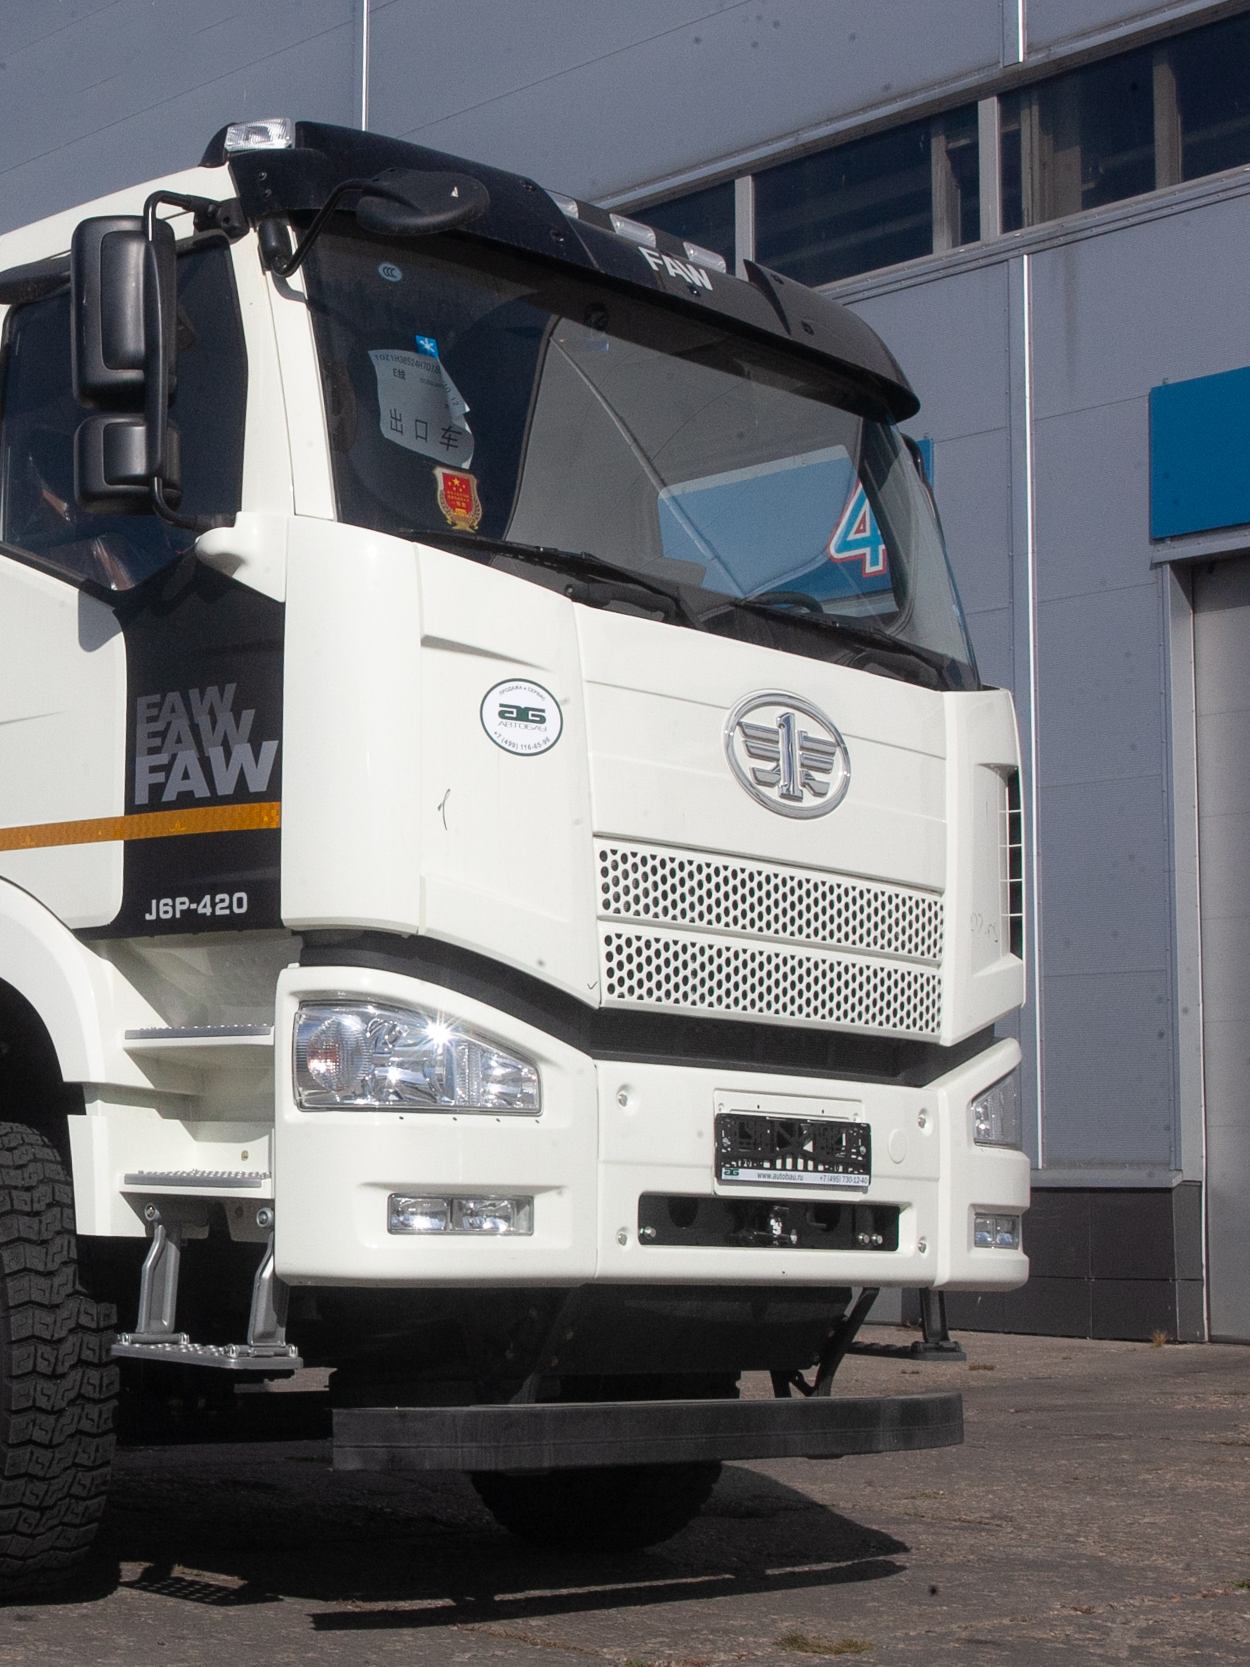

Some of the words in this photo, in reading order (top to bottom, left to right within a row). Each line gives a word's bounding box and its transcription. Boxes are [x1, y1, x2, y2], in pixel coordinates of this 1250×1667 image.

[638, 247, 713, 291] FAW
[388, 407, 462, 451] 出口车
[826, 478, 887, 578] 4
[137, 682, 237, 724] FAW
[136, 708, 256, 758] FAW
[501, 737, 519, 750] (499)
[134, 740, 279, 806] FAW
[145, 892, 248, 921] J6P-420
[757, 1172, 804, 1182] www.autobau.ru
[842, 1175, 868, 1185] 730-12-40
